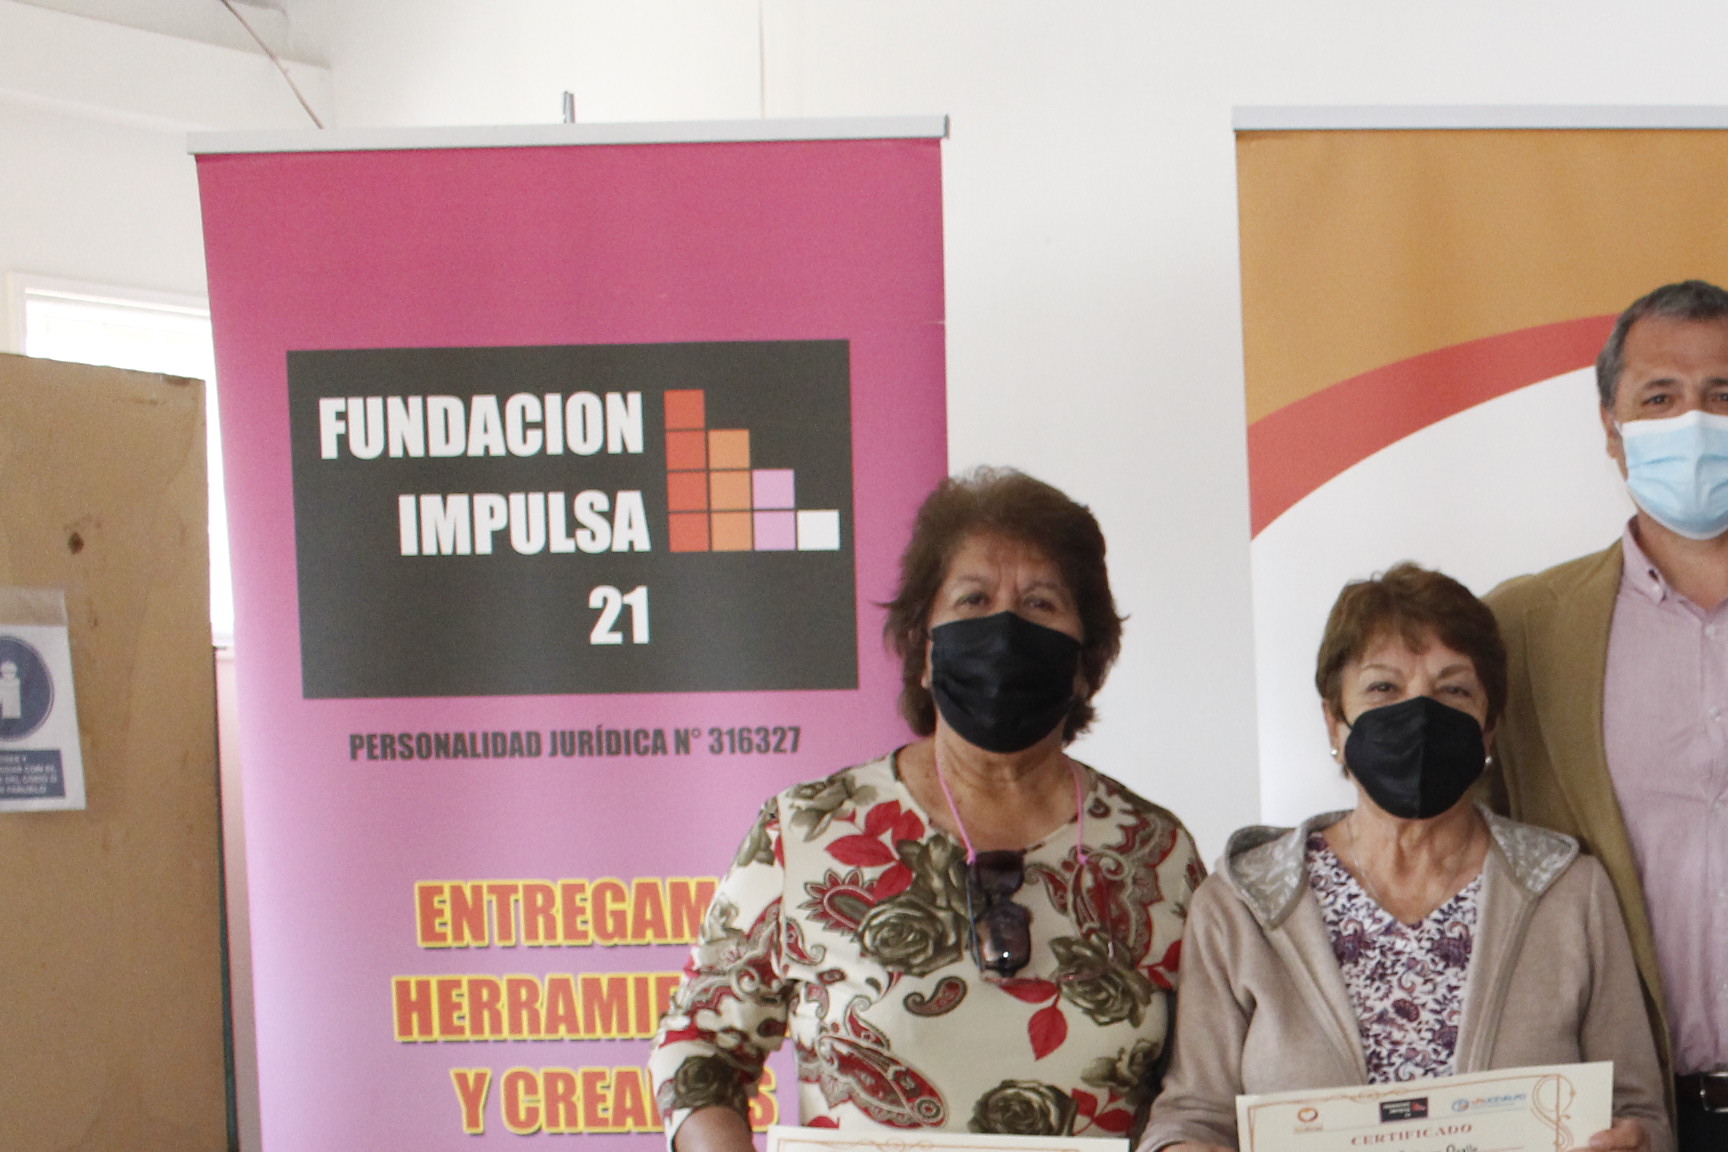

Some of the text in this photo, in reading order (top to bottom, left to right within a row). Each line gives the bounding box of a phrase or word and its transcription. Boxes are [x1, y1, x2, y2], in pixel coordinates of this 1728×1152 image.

[318, 391, 644, 460] FUNDACION
[398, 490, 652, 556] IMPULSA
[588, 586, 650, 645] 21
[348, 725, 802, 761] PERSONALIDAD JURÍDICA N° 316327
[449, 1067, 780, 1134] Y CREAS
[1350, 1124, 1473, 1146] CERTIFICADO
